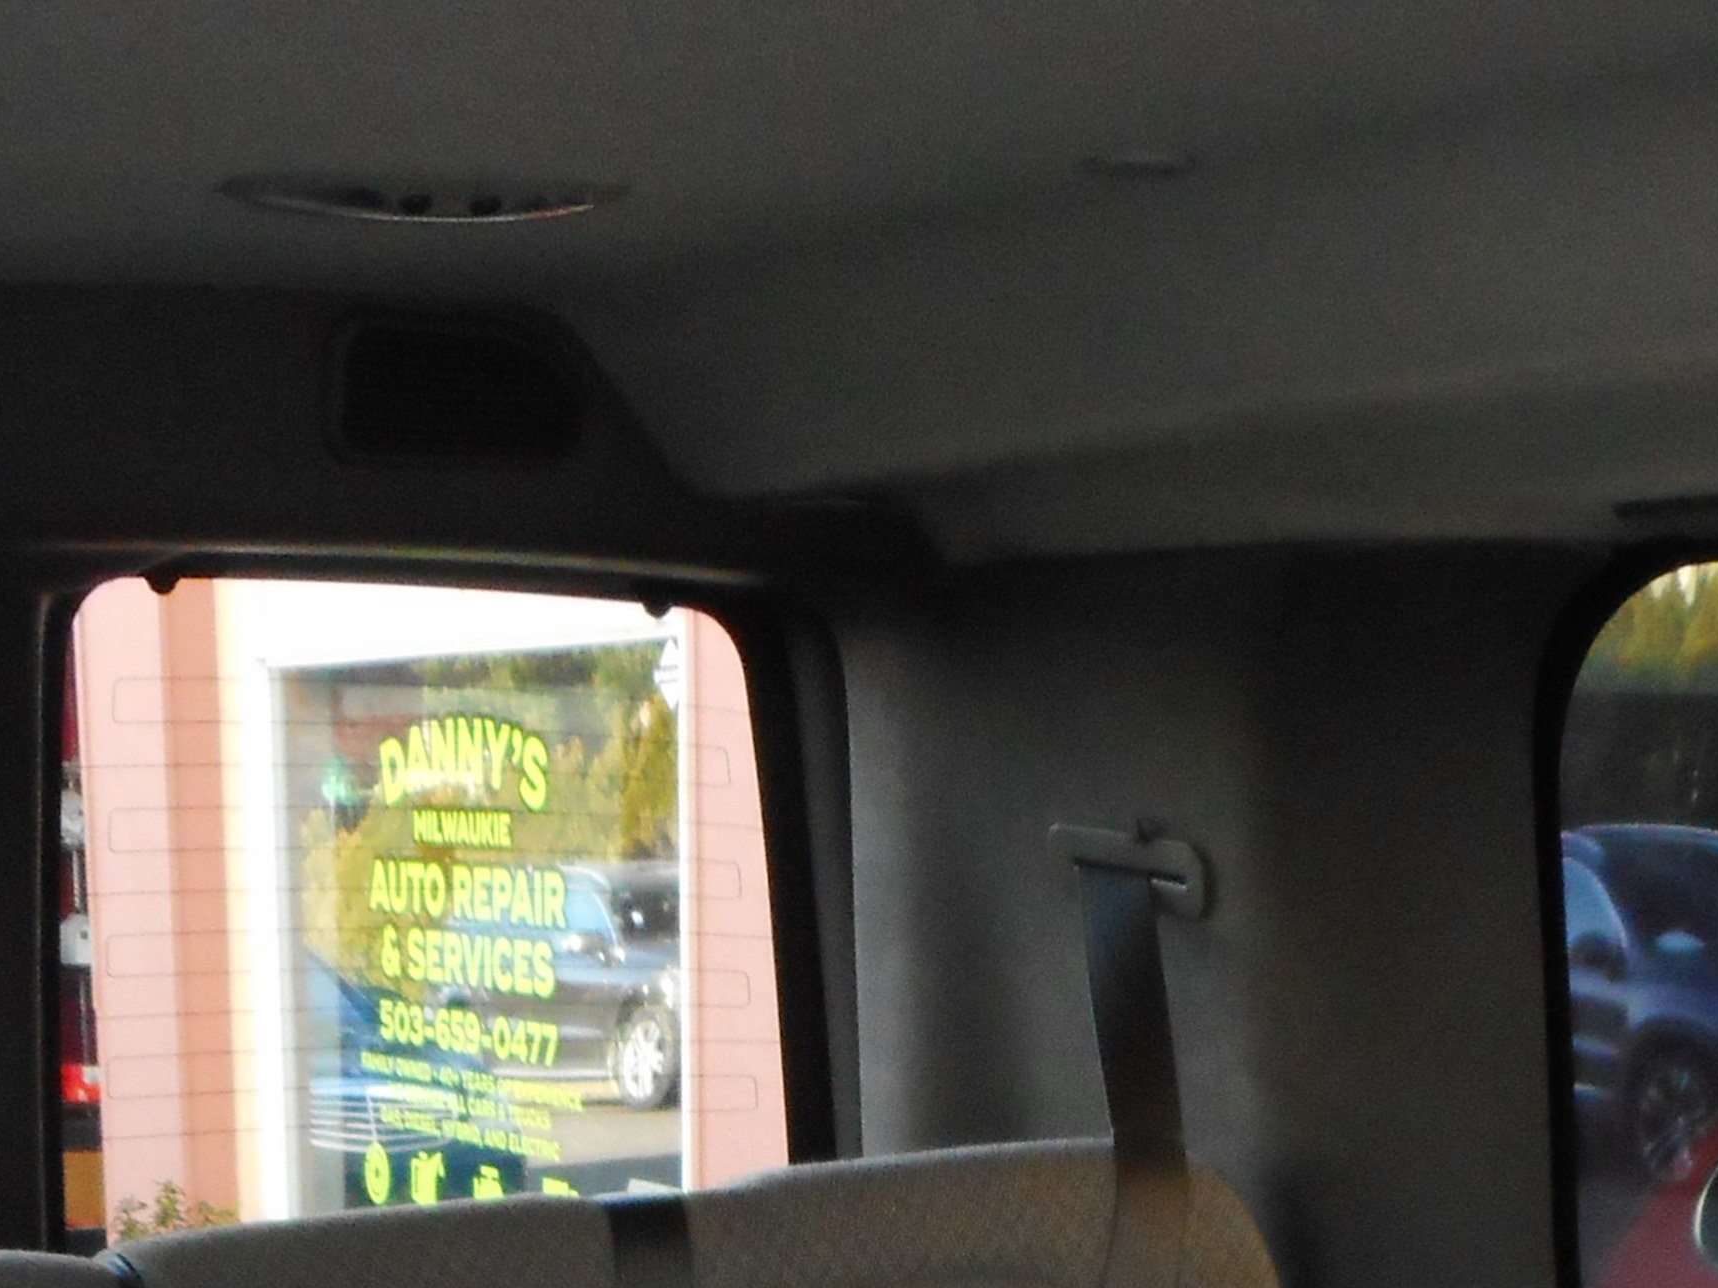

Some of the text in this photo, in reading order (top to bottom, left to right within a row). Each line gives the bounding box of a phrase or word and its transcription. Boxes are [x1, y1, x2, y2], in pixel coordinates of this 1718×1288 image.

[380, 716, 550, 811] DANNY'S
[413, 810, 513, 848] MILWAUKIE
[370, 859, 567, 929] AUTO REPAIR
[381, 924, 556, 999] & SERVICES
[379, 998, 560, 1067] 503-659-0477
[461, 1069, 496, 1094] YEARS
[484, 1128, 507, 1150] AND
